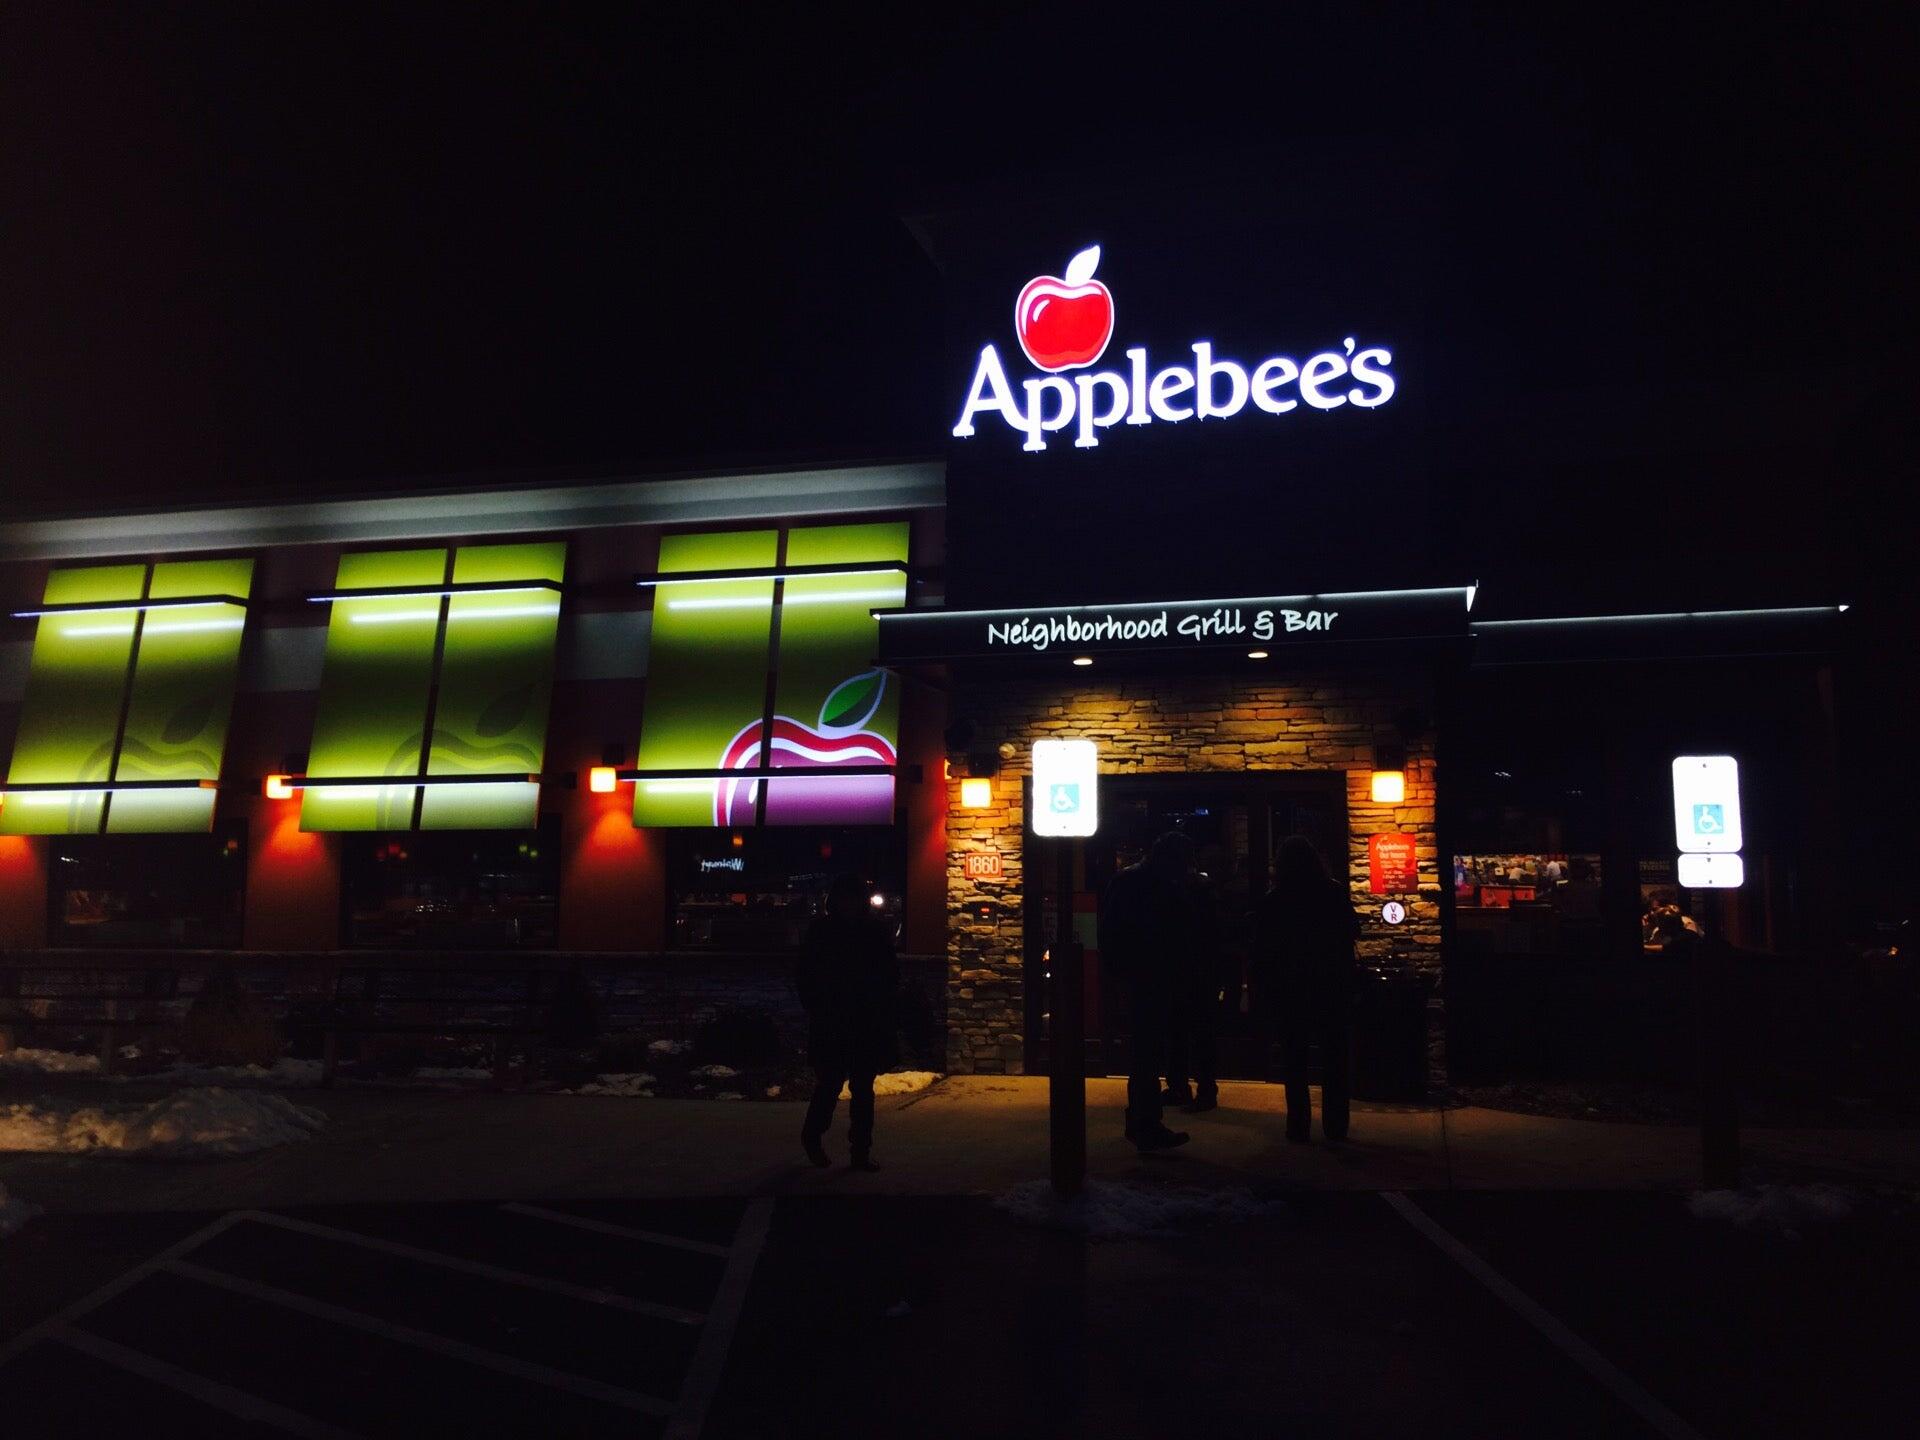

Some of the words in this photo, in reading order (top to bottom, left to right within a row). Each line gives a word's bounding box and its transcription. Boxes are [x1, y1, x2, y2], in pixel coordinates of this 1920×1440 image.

[952, 336, 1396, 452] Applebee's
[987, 611, 1168, 652] Neighborhood
[1177, 608, 1246, 641] Grill
[1252, 609, 1275, 641] &
[1281, 608, 1339, 634] Bar
[968, 855, 999, 875] 1860
[1389, 904, 1397, 913] V
[1390, 913, 1398, 922] R
